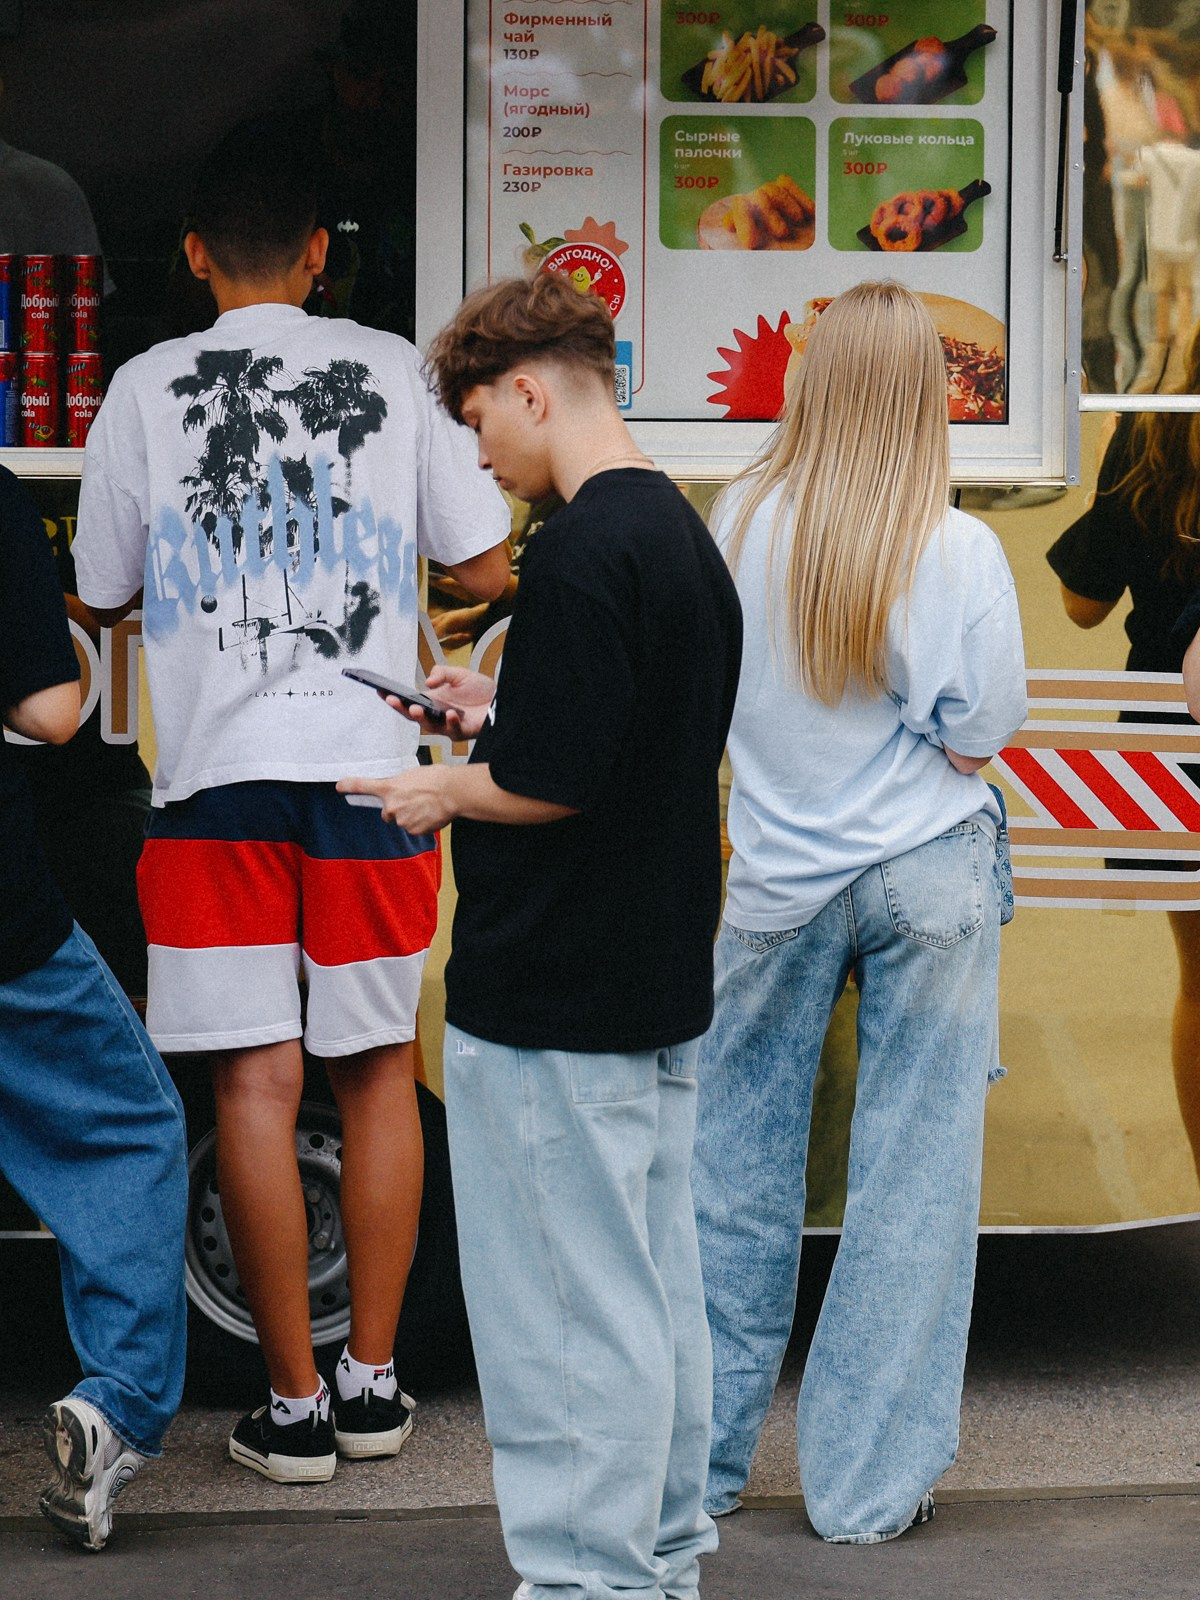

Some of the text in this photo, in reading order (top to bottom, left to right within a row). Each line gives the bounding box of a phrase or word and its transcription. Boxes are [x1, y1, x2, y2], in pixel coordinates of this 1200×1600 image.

[503, 12, 612, 28] Фирменный
[503, 30, 535, 43] чай
[503, 48, 540, 60] 130₽
[503, 84, 550, 99] Морс
[503, 102, 591, 118] (ягодный)
[503, 126, 542, 138] 200₽
[675, 130, 740, 144] Сырные
[843, 132, 974, 146] Луковые кольца
[675, 148, 742, 158] палочки
[503, 163, 593, 178] Газировка
[843, 162, 888, 175] 300₽
[502, 181, 542, 193] 230₽
[674, 176, 720, 189] 300₽
[547, 249, 613, 272] ВЫГОДНО!
[31, 310, 50, 319] cola
[70, 310, 88, 318] cola
[21, 392, 50, 408] брый
[74, 409, 93, 418] cola
[248, 689, 334, 698] LAY HARD
[373, 1368, 394, 1381] FIL
